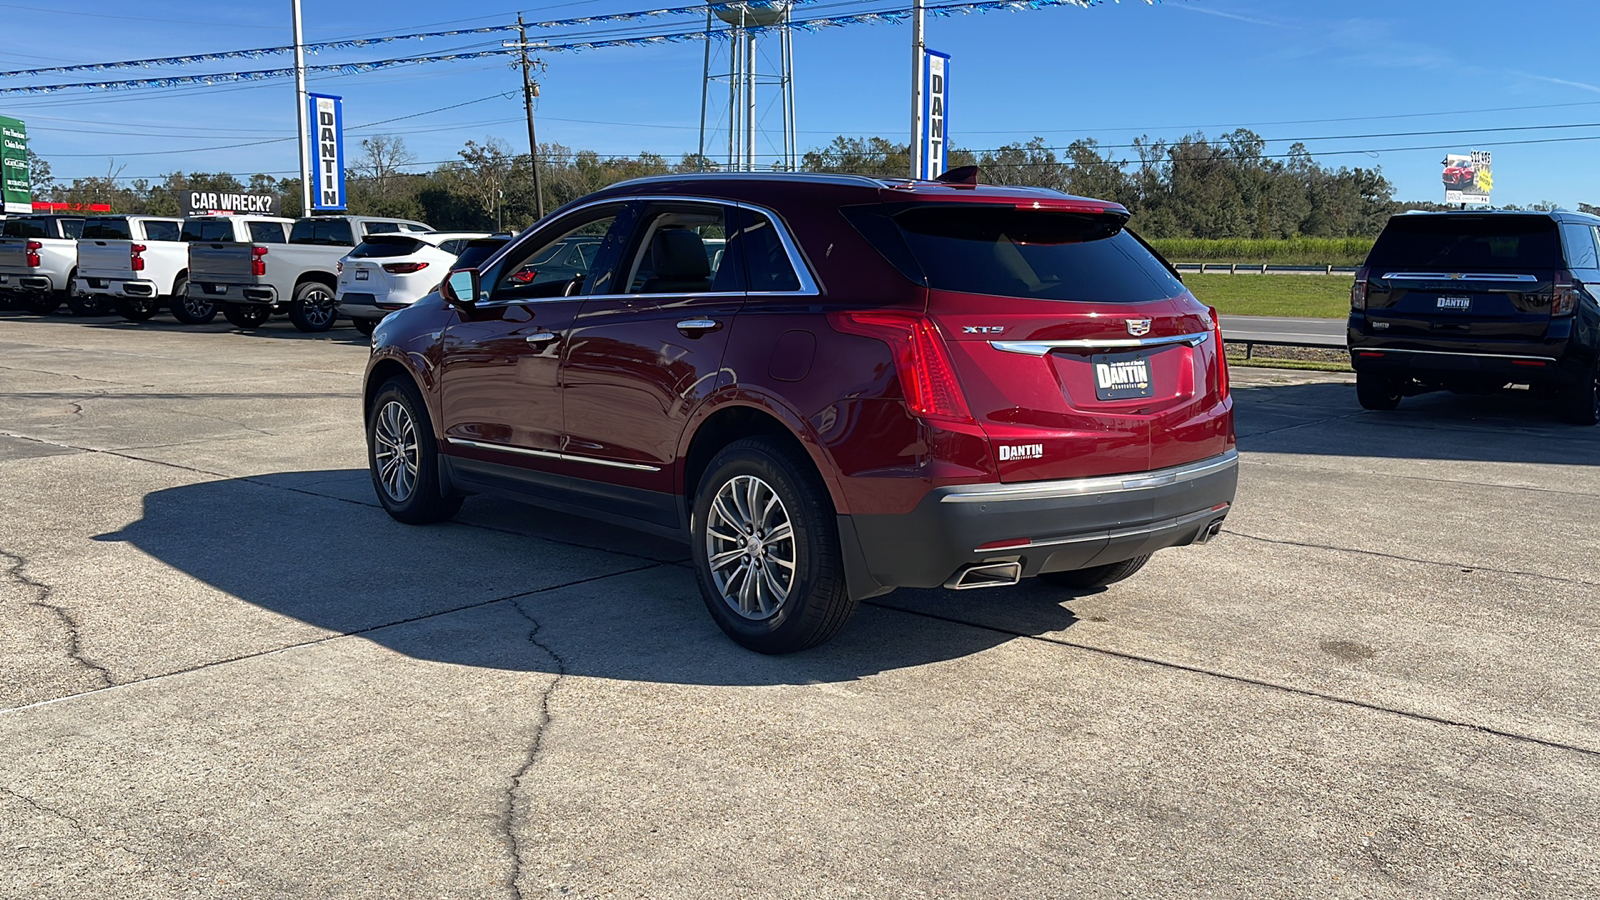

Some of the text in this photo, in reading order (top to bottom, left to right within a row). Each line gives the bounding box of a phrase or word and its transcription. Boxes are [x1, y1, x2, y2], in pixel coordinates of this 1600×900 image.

[932, 74, 942, 180] DANTI
[320, 111, 336, 205] DANTIN
[191, 192, 273, 212] CAR WRECK?
[1437, 297, 1470, 308] DANTIN
[962, 326, 1005, 334] XT5
[1096, 364, 1148, 389] DANTIN
[999, 443, 1043, 461] DANTIN
